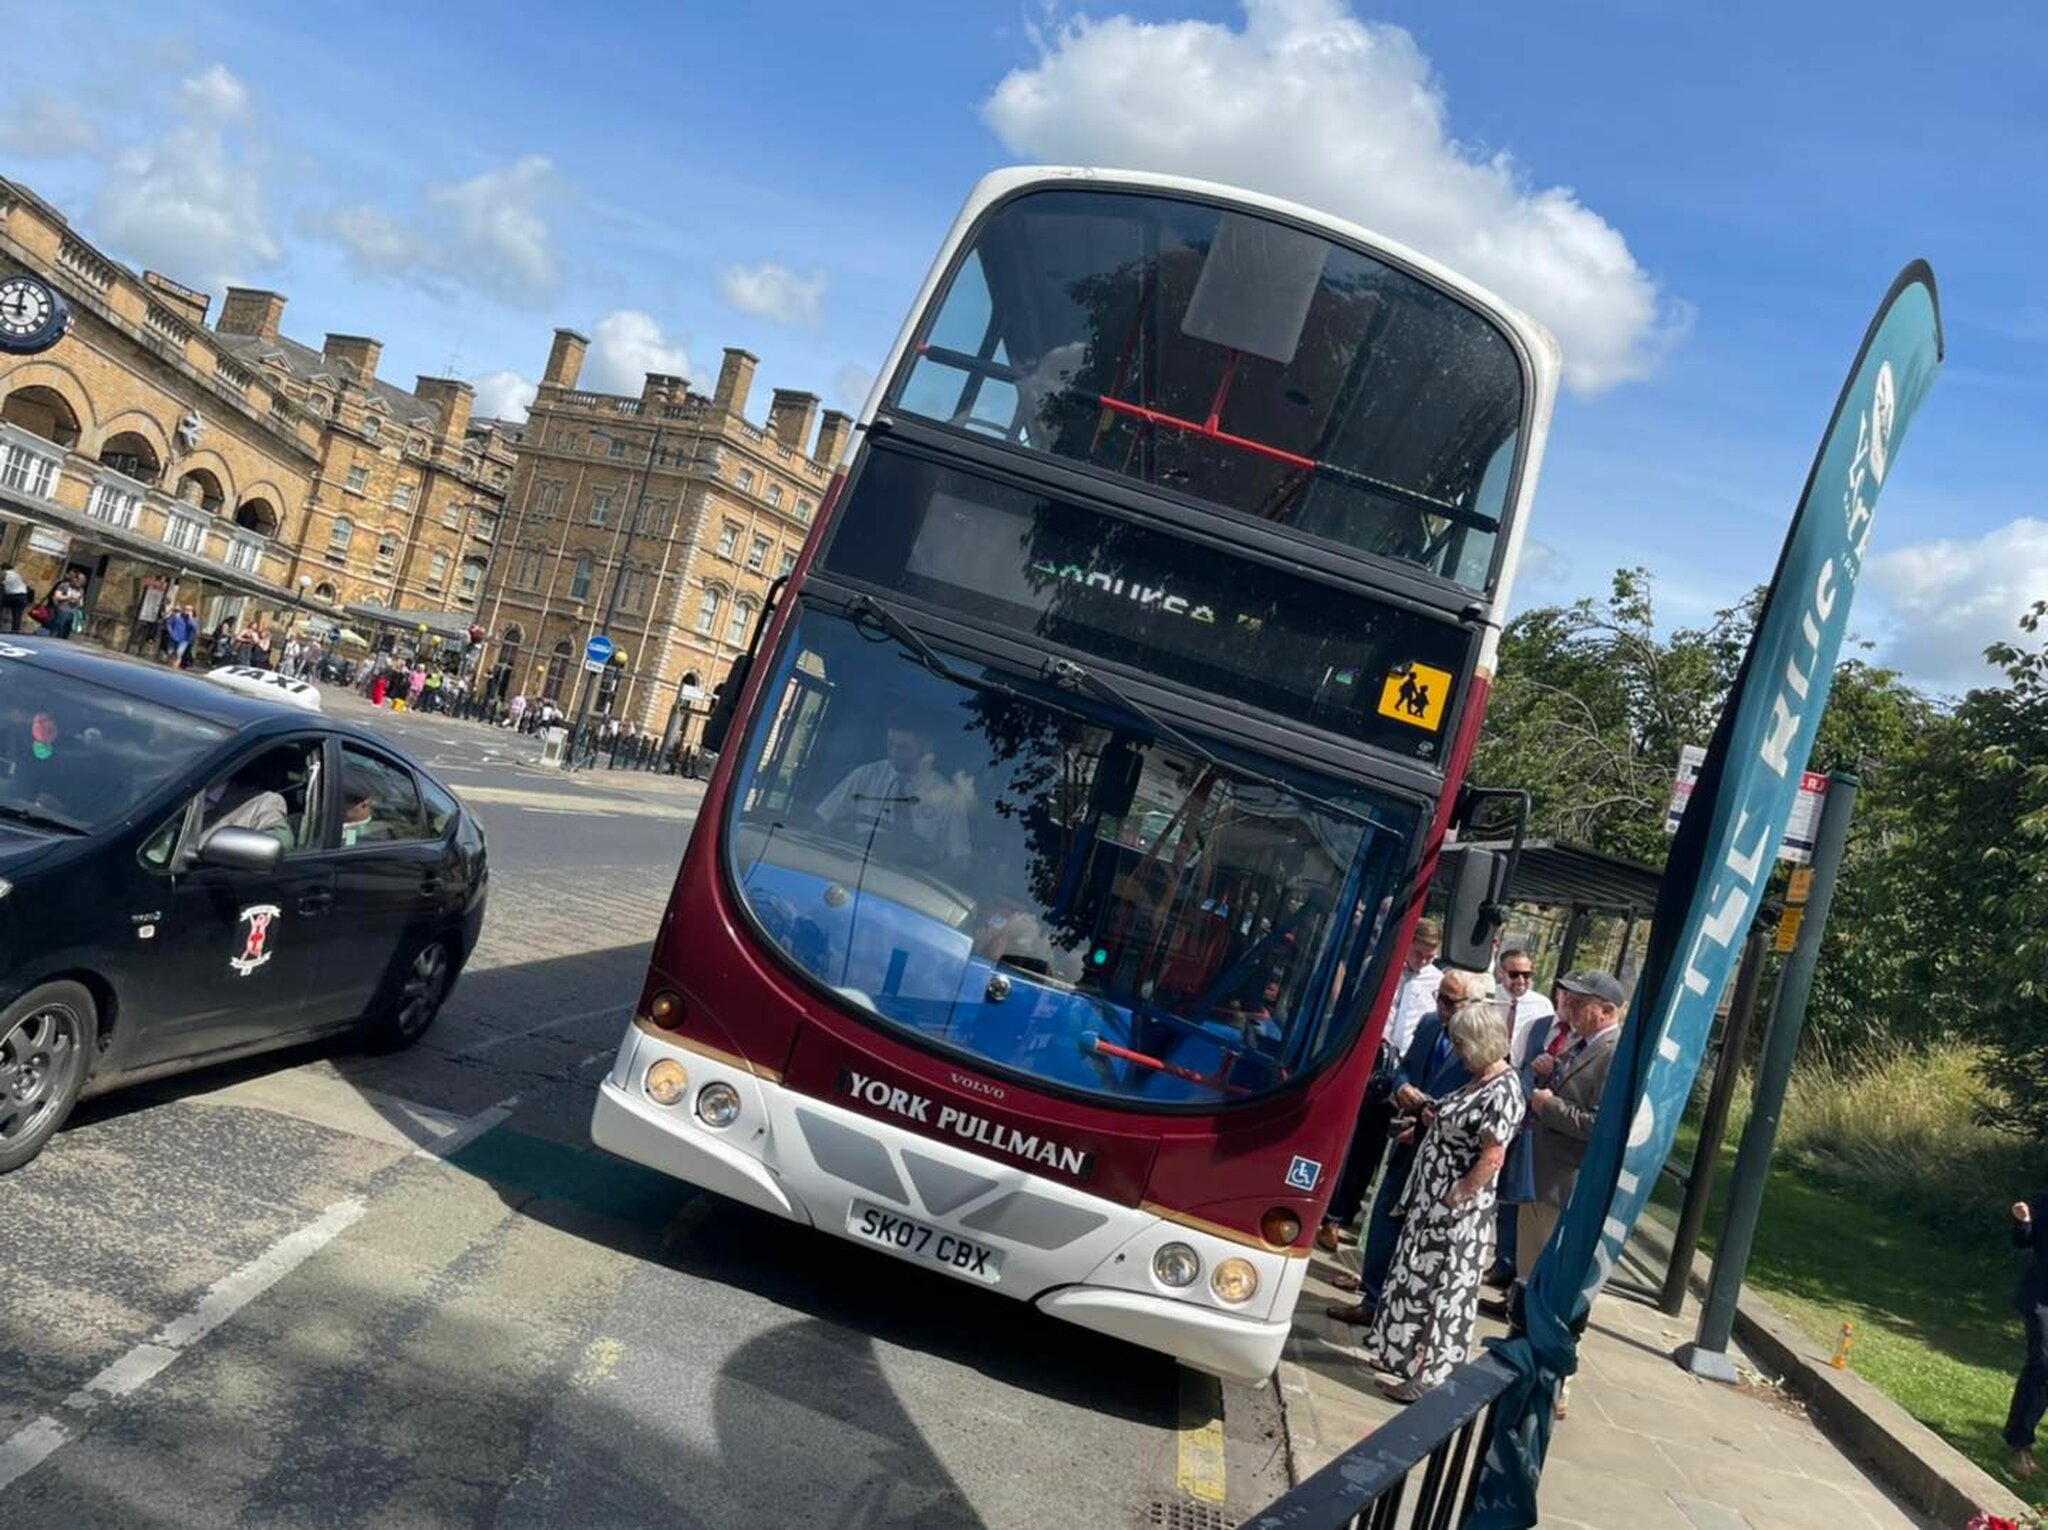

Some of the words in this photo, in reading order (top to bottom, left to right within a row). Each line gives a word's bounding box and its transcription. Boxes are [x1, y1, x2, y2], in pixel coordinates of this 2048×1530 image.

[226, 665, 311, 693] TAXI
[950, 1073, 1006, 1099] VOLVO
[850, 1072, 931, 1122] YORK
[936, 1105, 1085, 1174] PULLMAN
[861, 1209, 933, 1252] SK07
[936, 1236, 991, 1275] CBX
